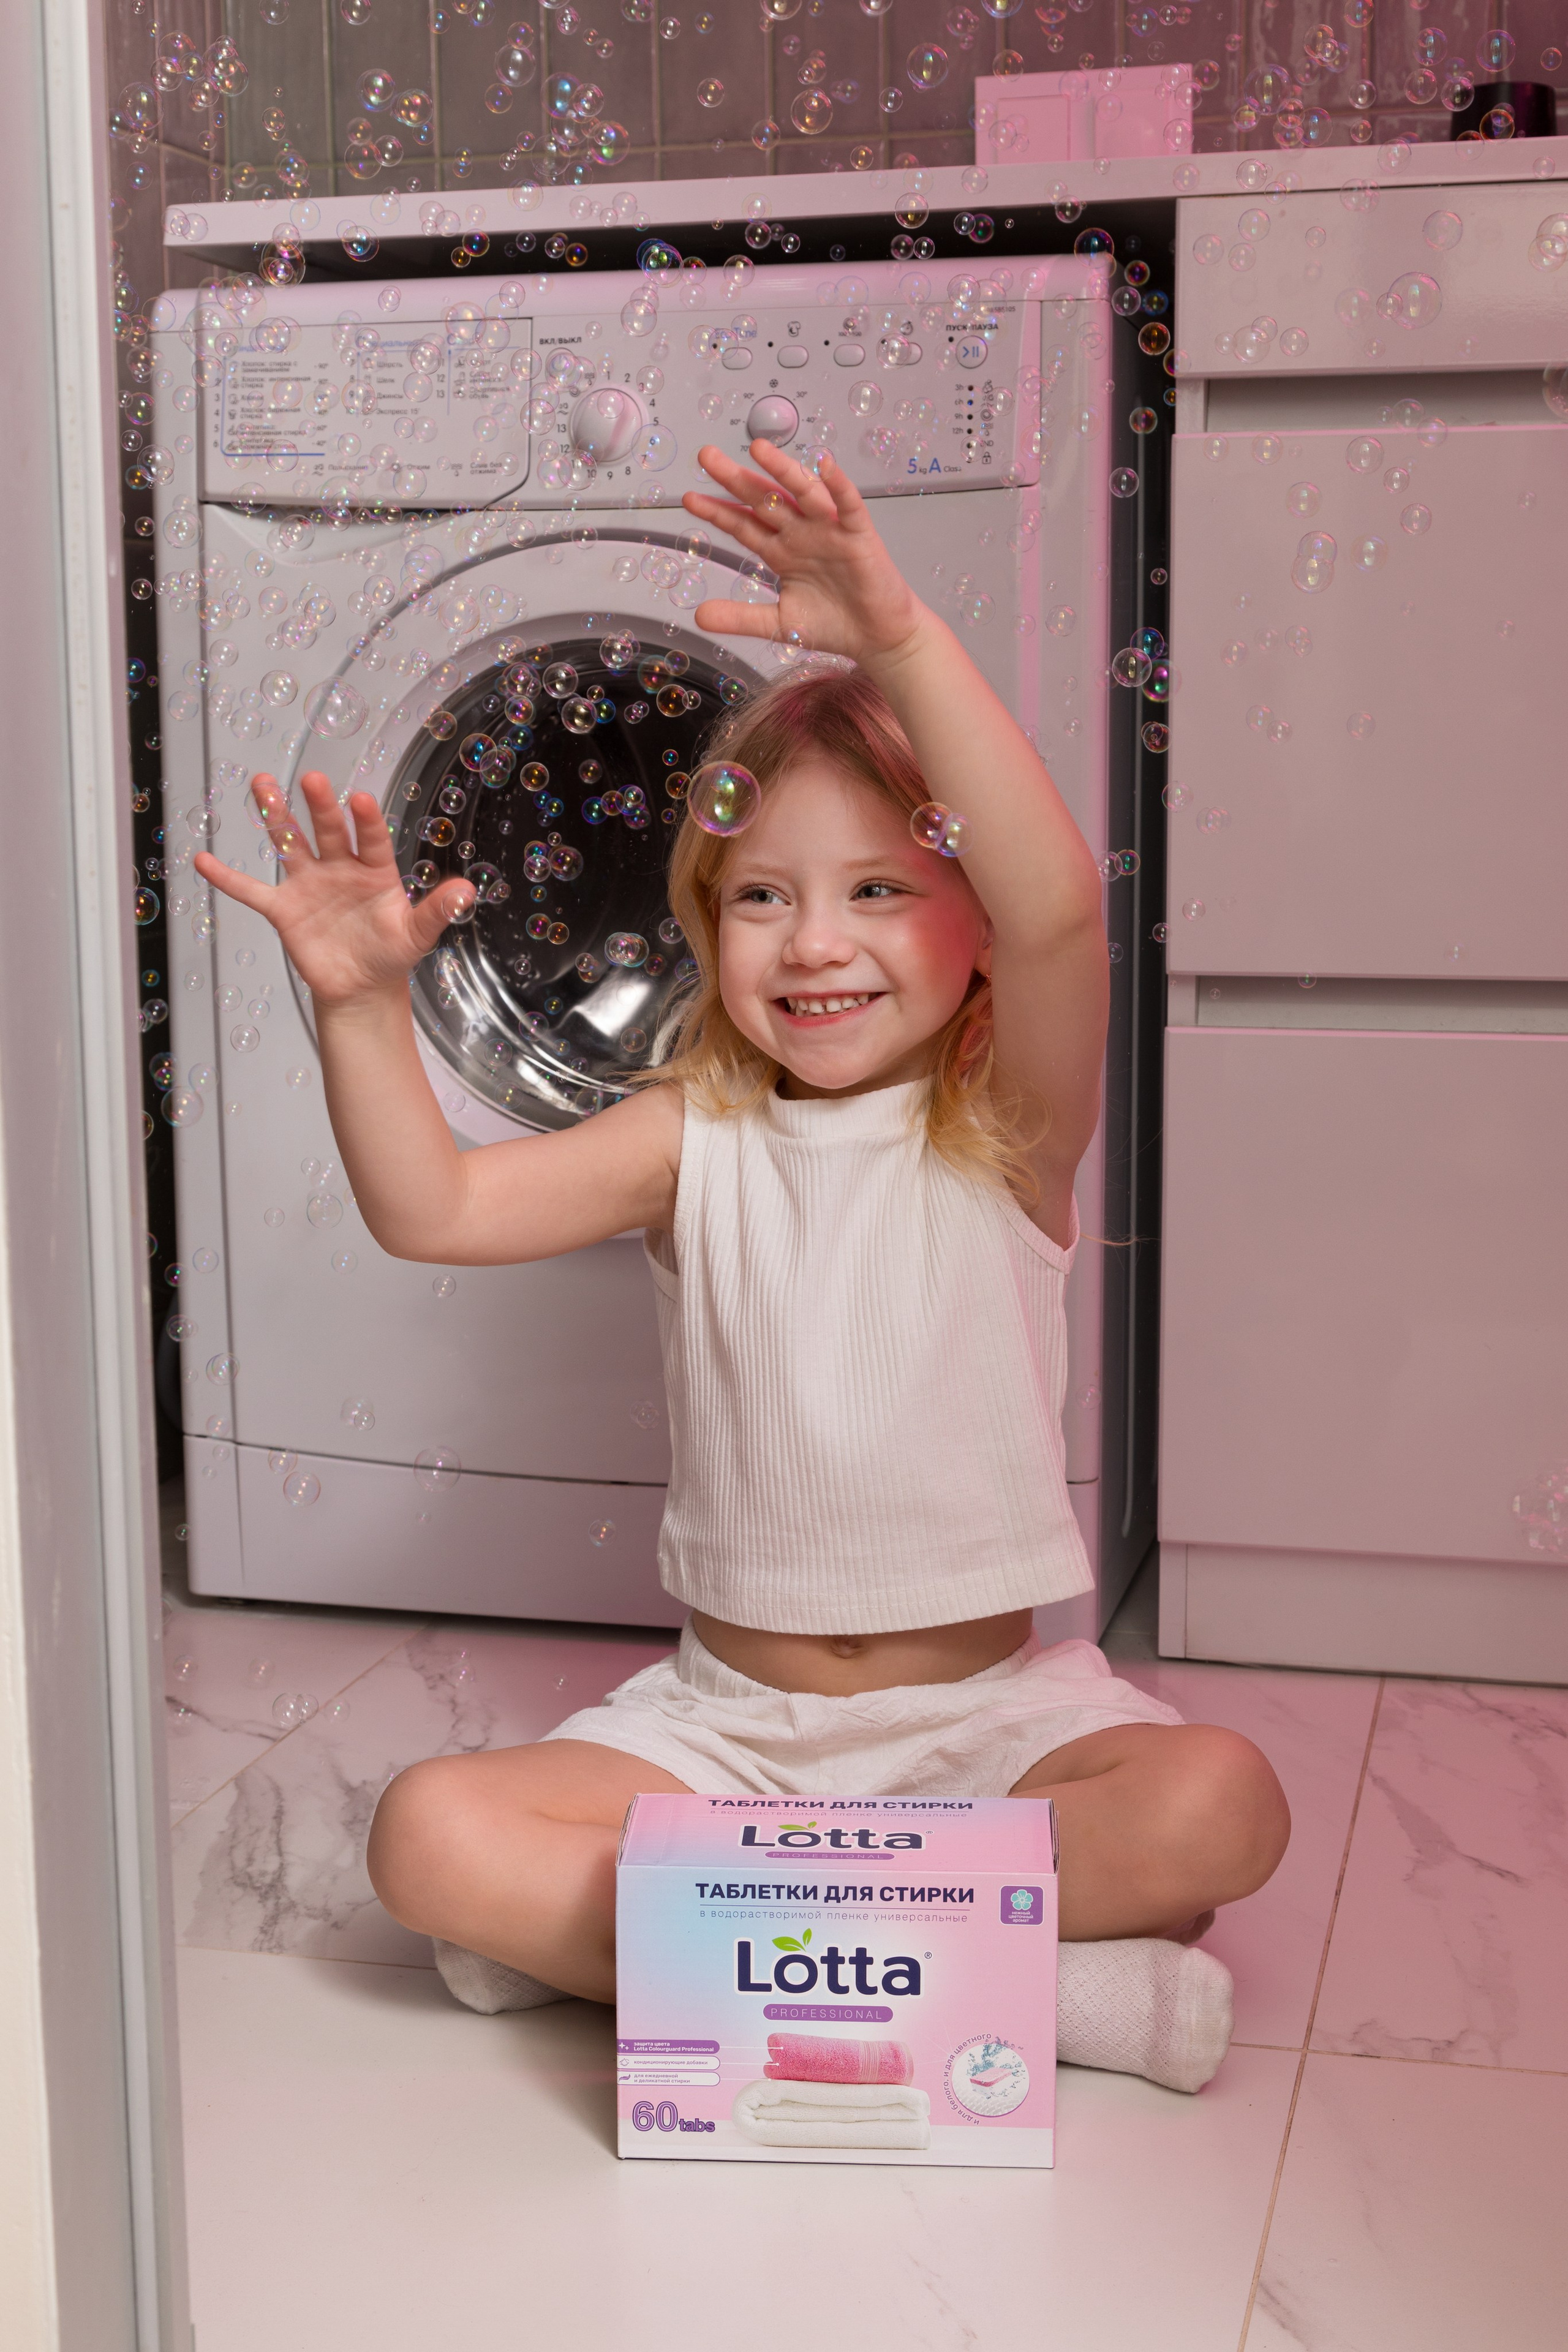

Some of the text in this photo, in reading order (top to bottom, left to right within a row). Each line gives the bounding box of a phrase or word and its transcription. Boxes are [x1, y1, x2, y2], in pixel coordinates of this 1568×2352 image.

[624, 373, 630, 382] 2
[436, 390, 445, 398] 13
[649, 398, 655, 407] 4
[557, 424, 567, 432] 13
[653, 417, 659, 426] 5
[649, 436, 655, 445] 6
[560, 444, 570, 453] 12
[907, 458, 918, 474] 5
[929, 458, 942, 473] A
[606, 471, 612, 480] 9
[625, 466, 631, 475] 8
[708, 1799, 824, 1809] ТАБЛЕТКИ
[830, 1801, 877, 1810] ДЛЯ
[741, 1825, 923, 1850] Lotta
[695, 1883, 975, 1904] ТАБЛЕТКИ ДЛЯ СТИРКИ
[710, 1909, 822, 1921] водорастворимой
[874, 1913, 968, 1923] универсальные
[737, 1941, 921, 1996] Lotta
[771, 2008, 882, 2020] PROFESSIONAL
[953, 2033, 992, 2055] цветного
[944, 2054, 956, 2071] для
[632, 2101, 715, 2132] 60 tabs
[957, 2109, 974, 2122] для
